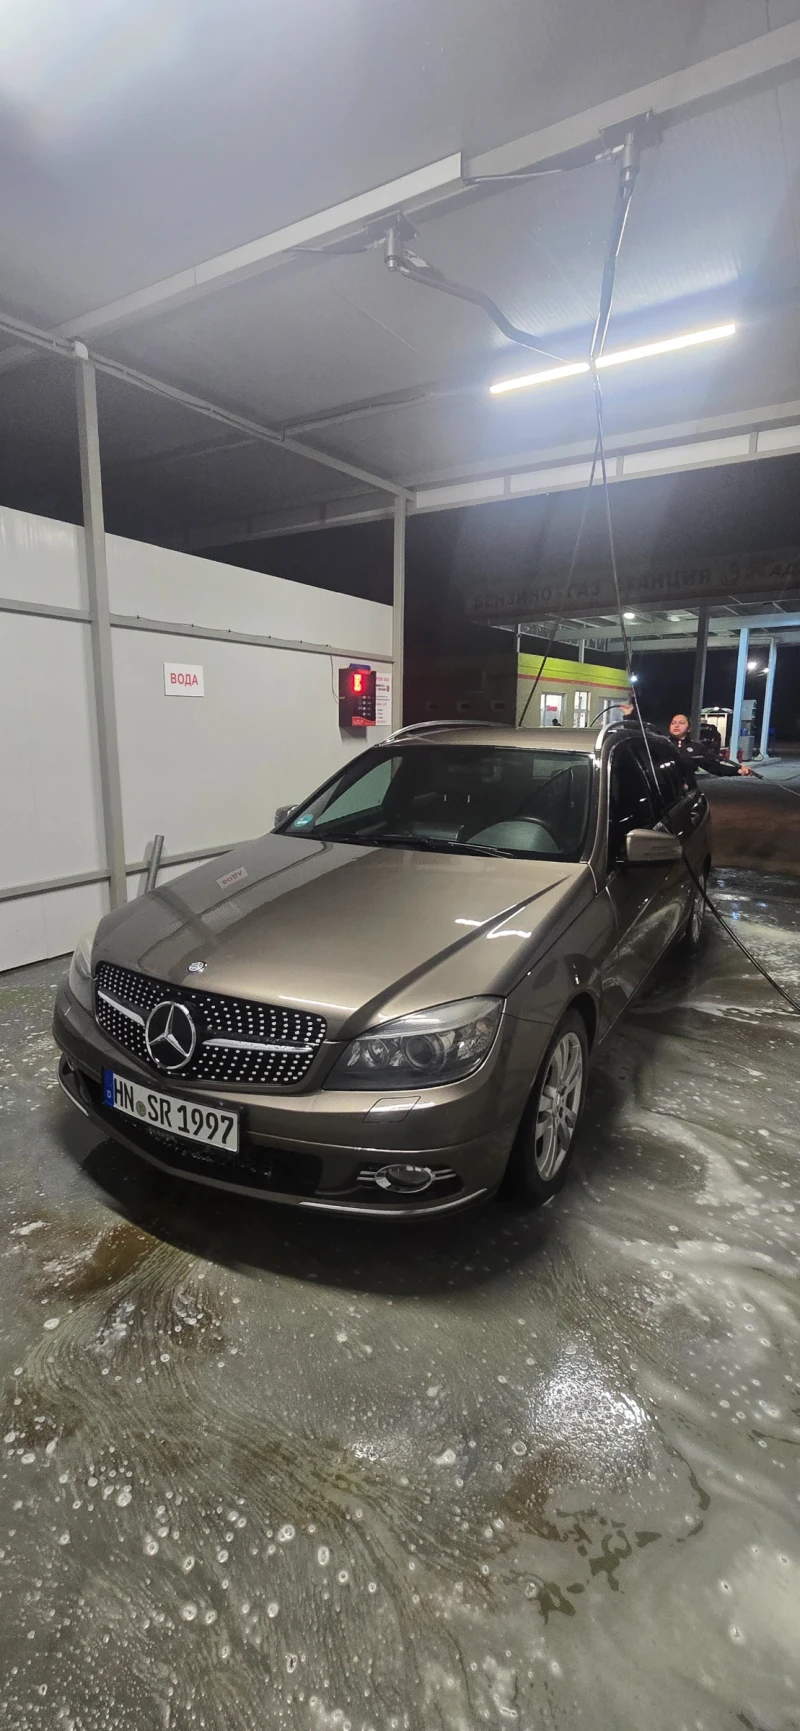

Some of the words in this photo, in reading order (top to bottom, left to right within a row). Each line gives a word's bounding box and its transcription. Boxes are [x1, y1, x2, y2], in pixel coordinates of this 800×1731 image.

[170, 672, 199, 687] ВОДА
[113, 1077, 135, 1113] HN
[147, 1094, 172, 1128] SR
[177, 1104, 234, 1144] 1997
